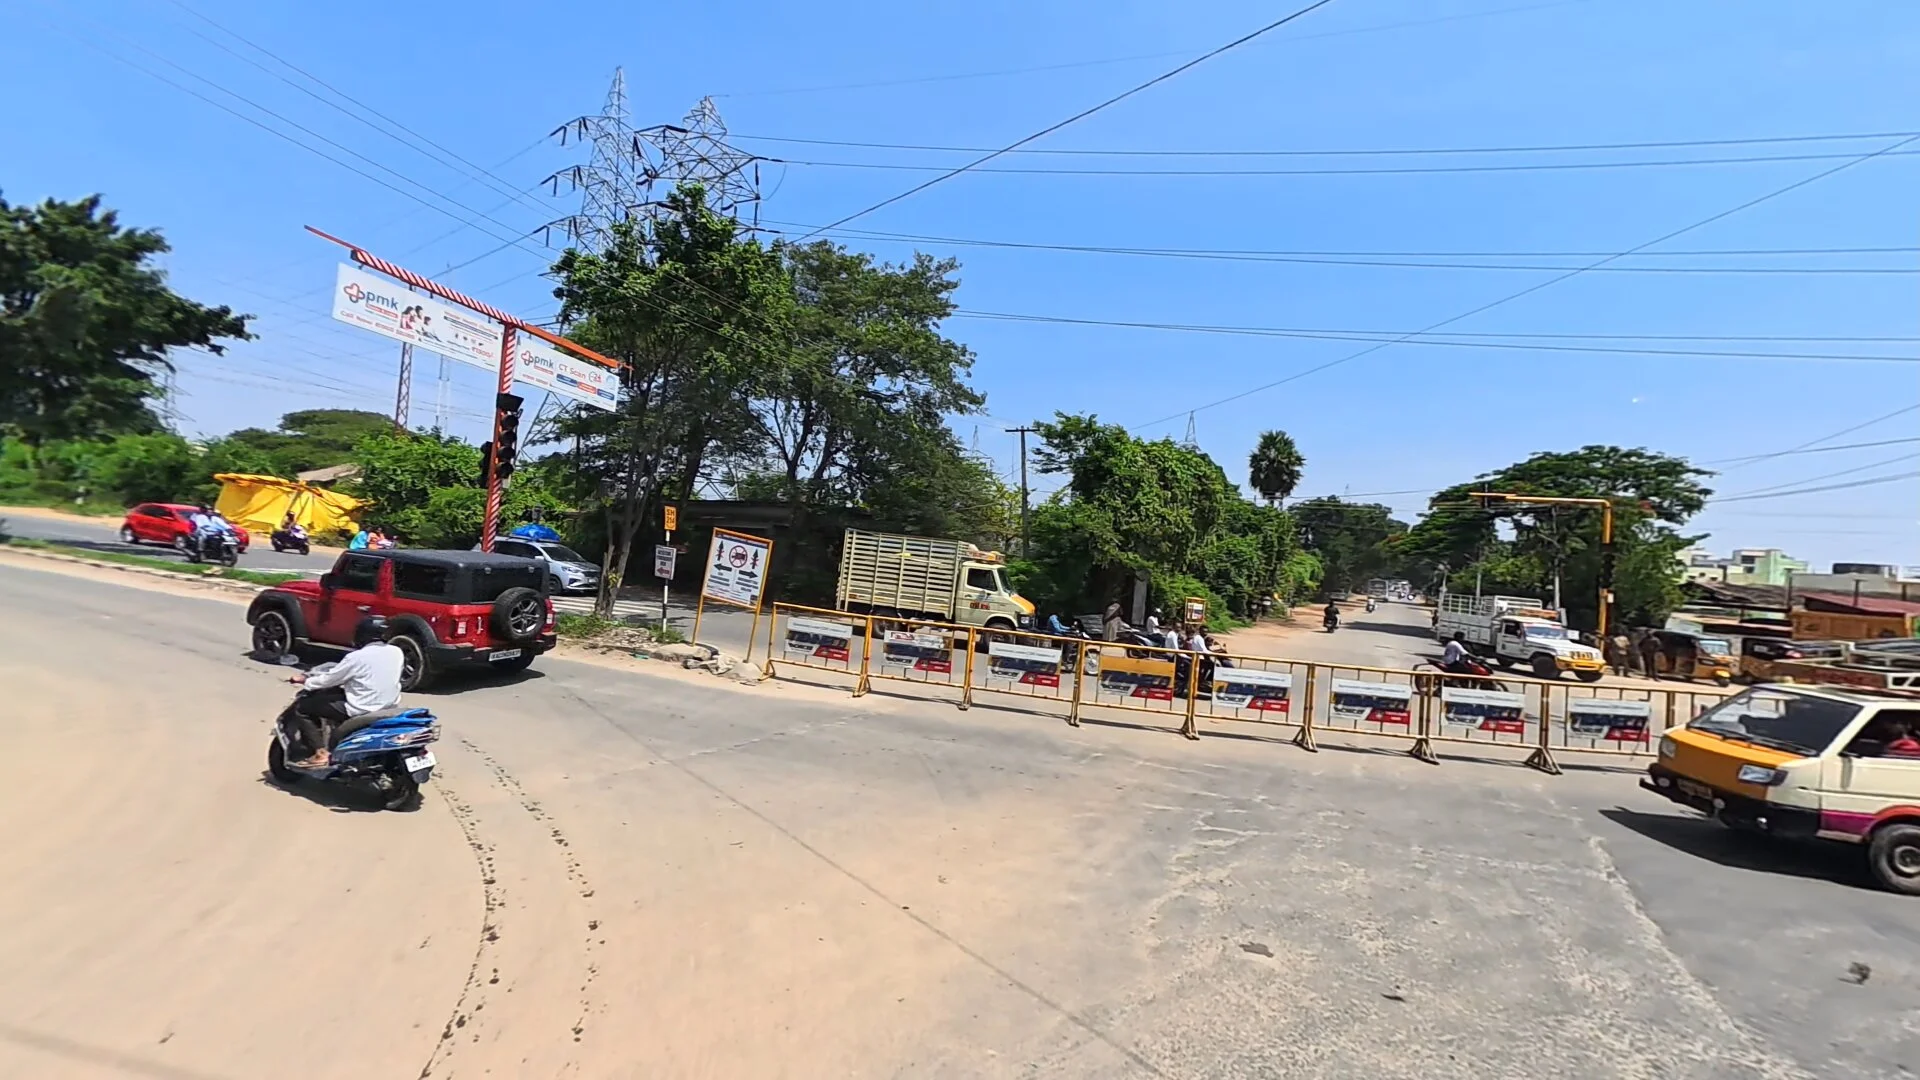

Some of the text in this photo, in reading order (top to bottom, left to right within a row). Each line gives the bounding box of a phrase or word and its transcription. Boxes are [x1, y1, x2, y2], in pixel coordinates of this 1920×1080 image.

[366, 291, 399, 311] pmk
[534, 356, 554, 369] pmk
[570, 367, 586, 379] Scan
